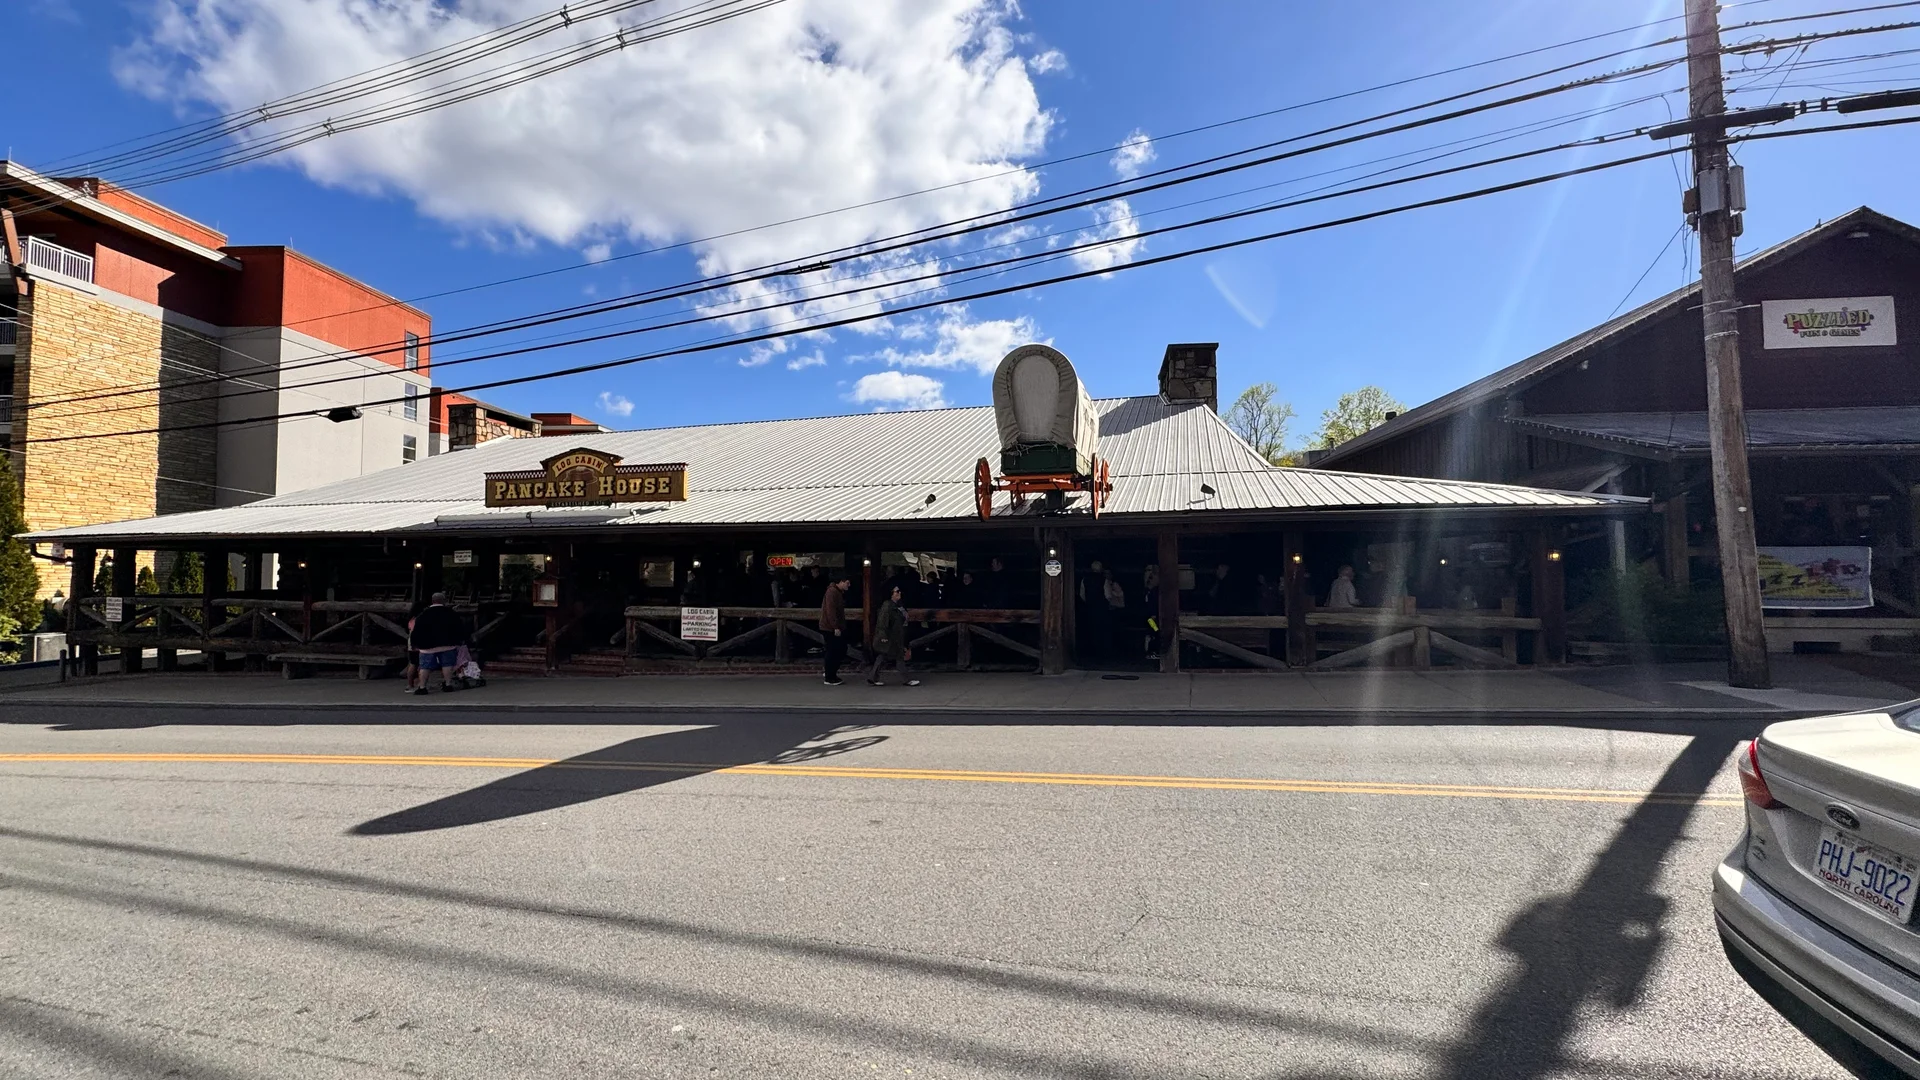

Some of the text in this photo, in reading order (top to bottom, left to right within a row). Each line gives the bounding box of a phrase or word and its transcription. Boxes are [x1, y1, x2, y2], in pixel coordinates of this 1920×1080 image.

[1786, 310, 1870, 328] PUZZLED
[1801, 329, 1820, 338] FUN
[1829, 328, 1861, 336] GAMES
[556, 455, 603, 472] LOG CABIN
[494, 476, 671, 499] PANCAKE HOUSE
[769, 557, 792, 566] OPEN
[1818, 839, 1912, 906] PHJ-9022
[1818, 868, 1900, 916] NORTH CAROLINA
